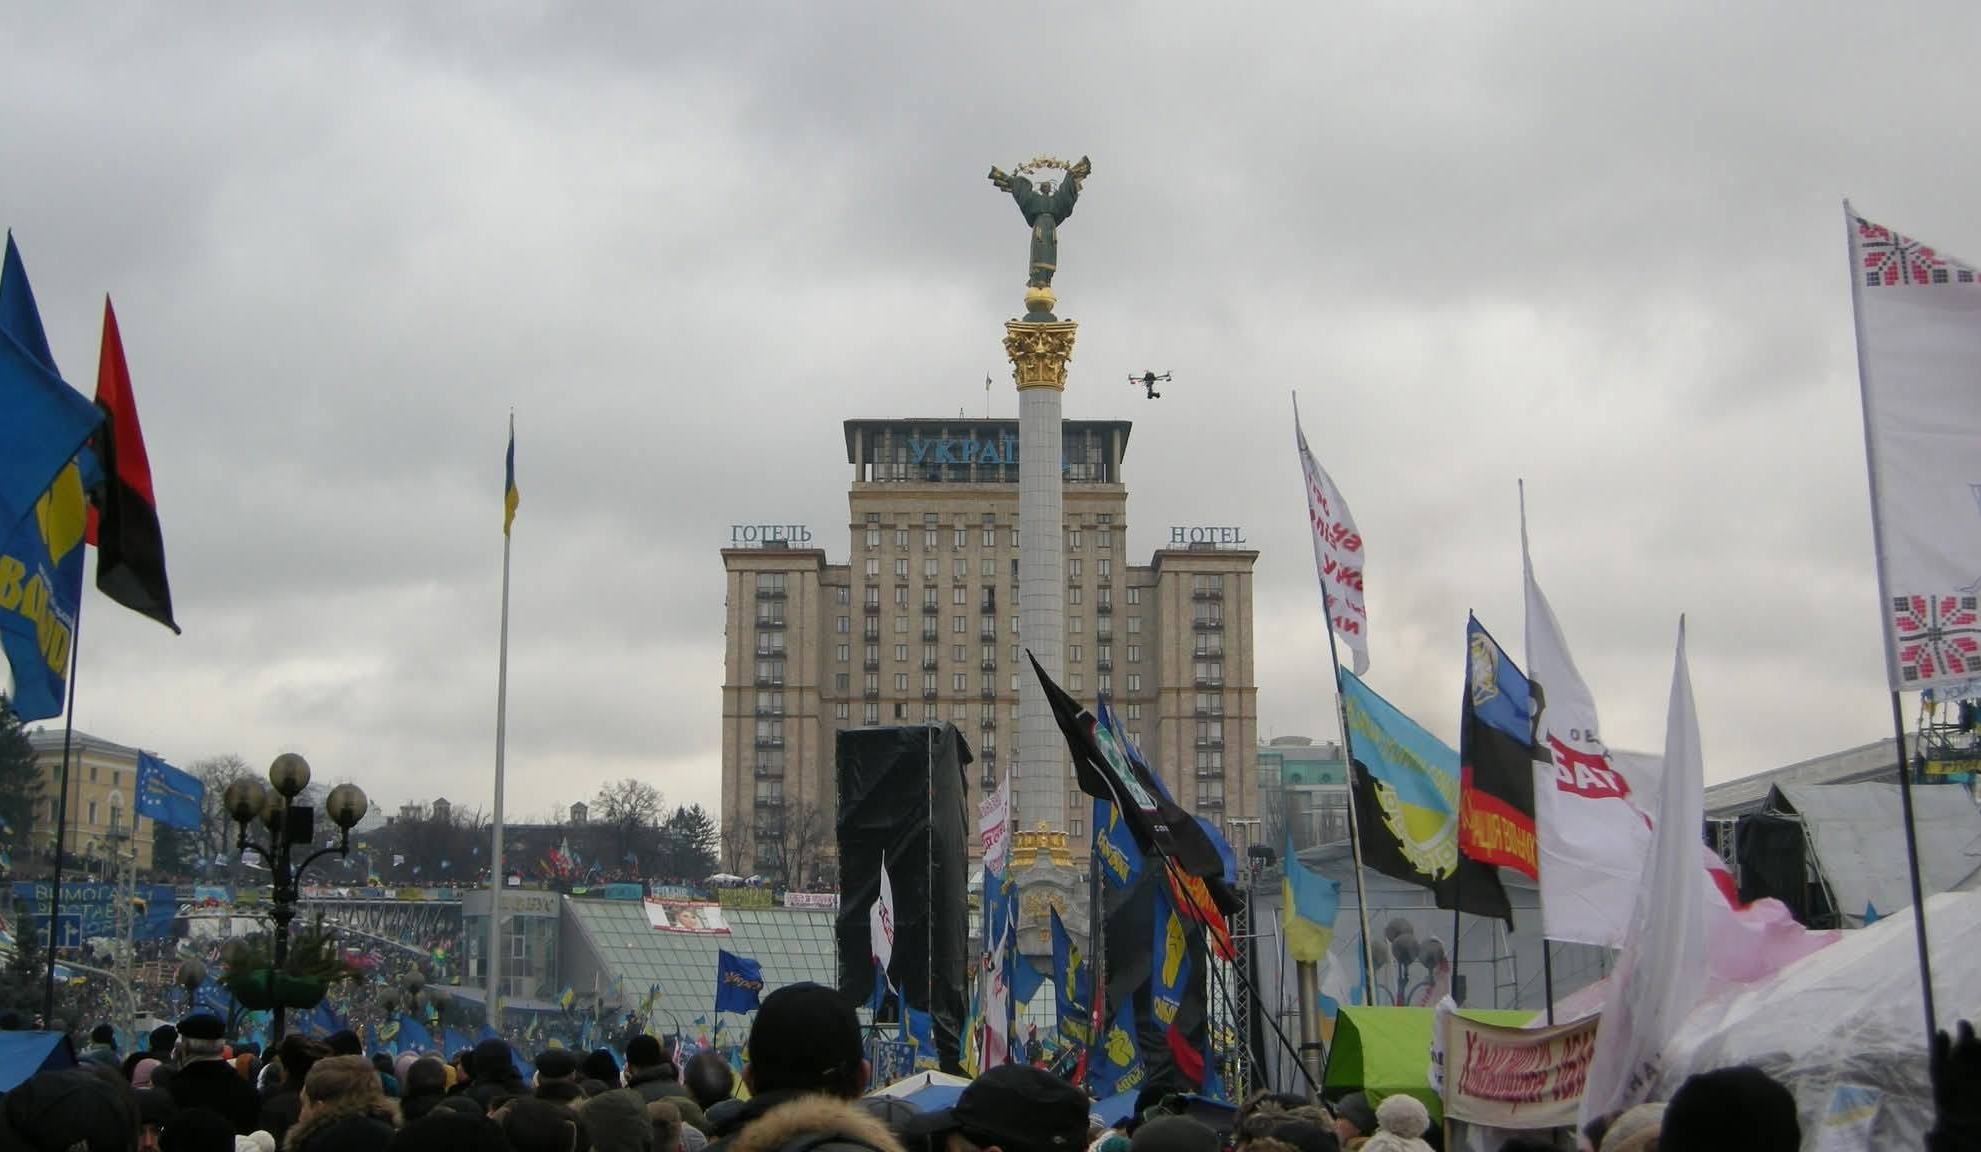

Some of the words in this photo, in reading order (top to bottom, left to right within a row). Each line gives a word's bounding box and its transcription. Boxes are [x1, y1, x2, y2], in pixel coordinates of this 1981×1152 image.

[909, 434, 1018, 464] УКРАЇ
[729, 524, 813, 543] ГОТЕЛЬ
[1169, 526, 1247, 544] HOTEL
